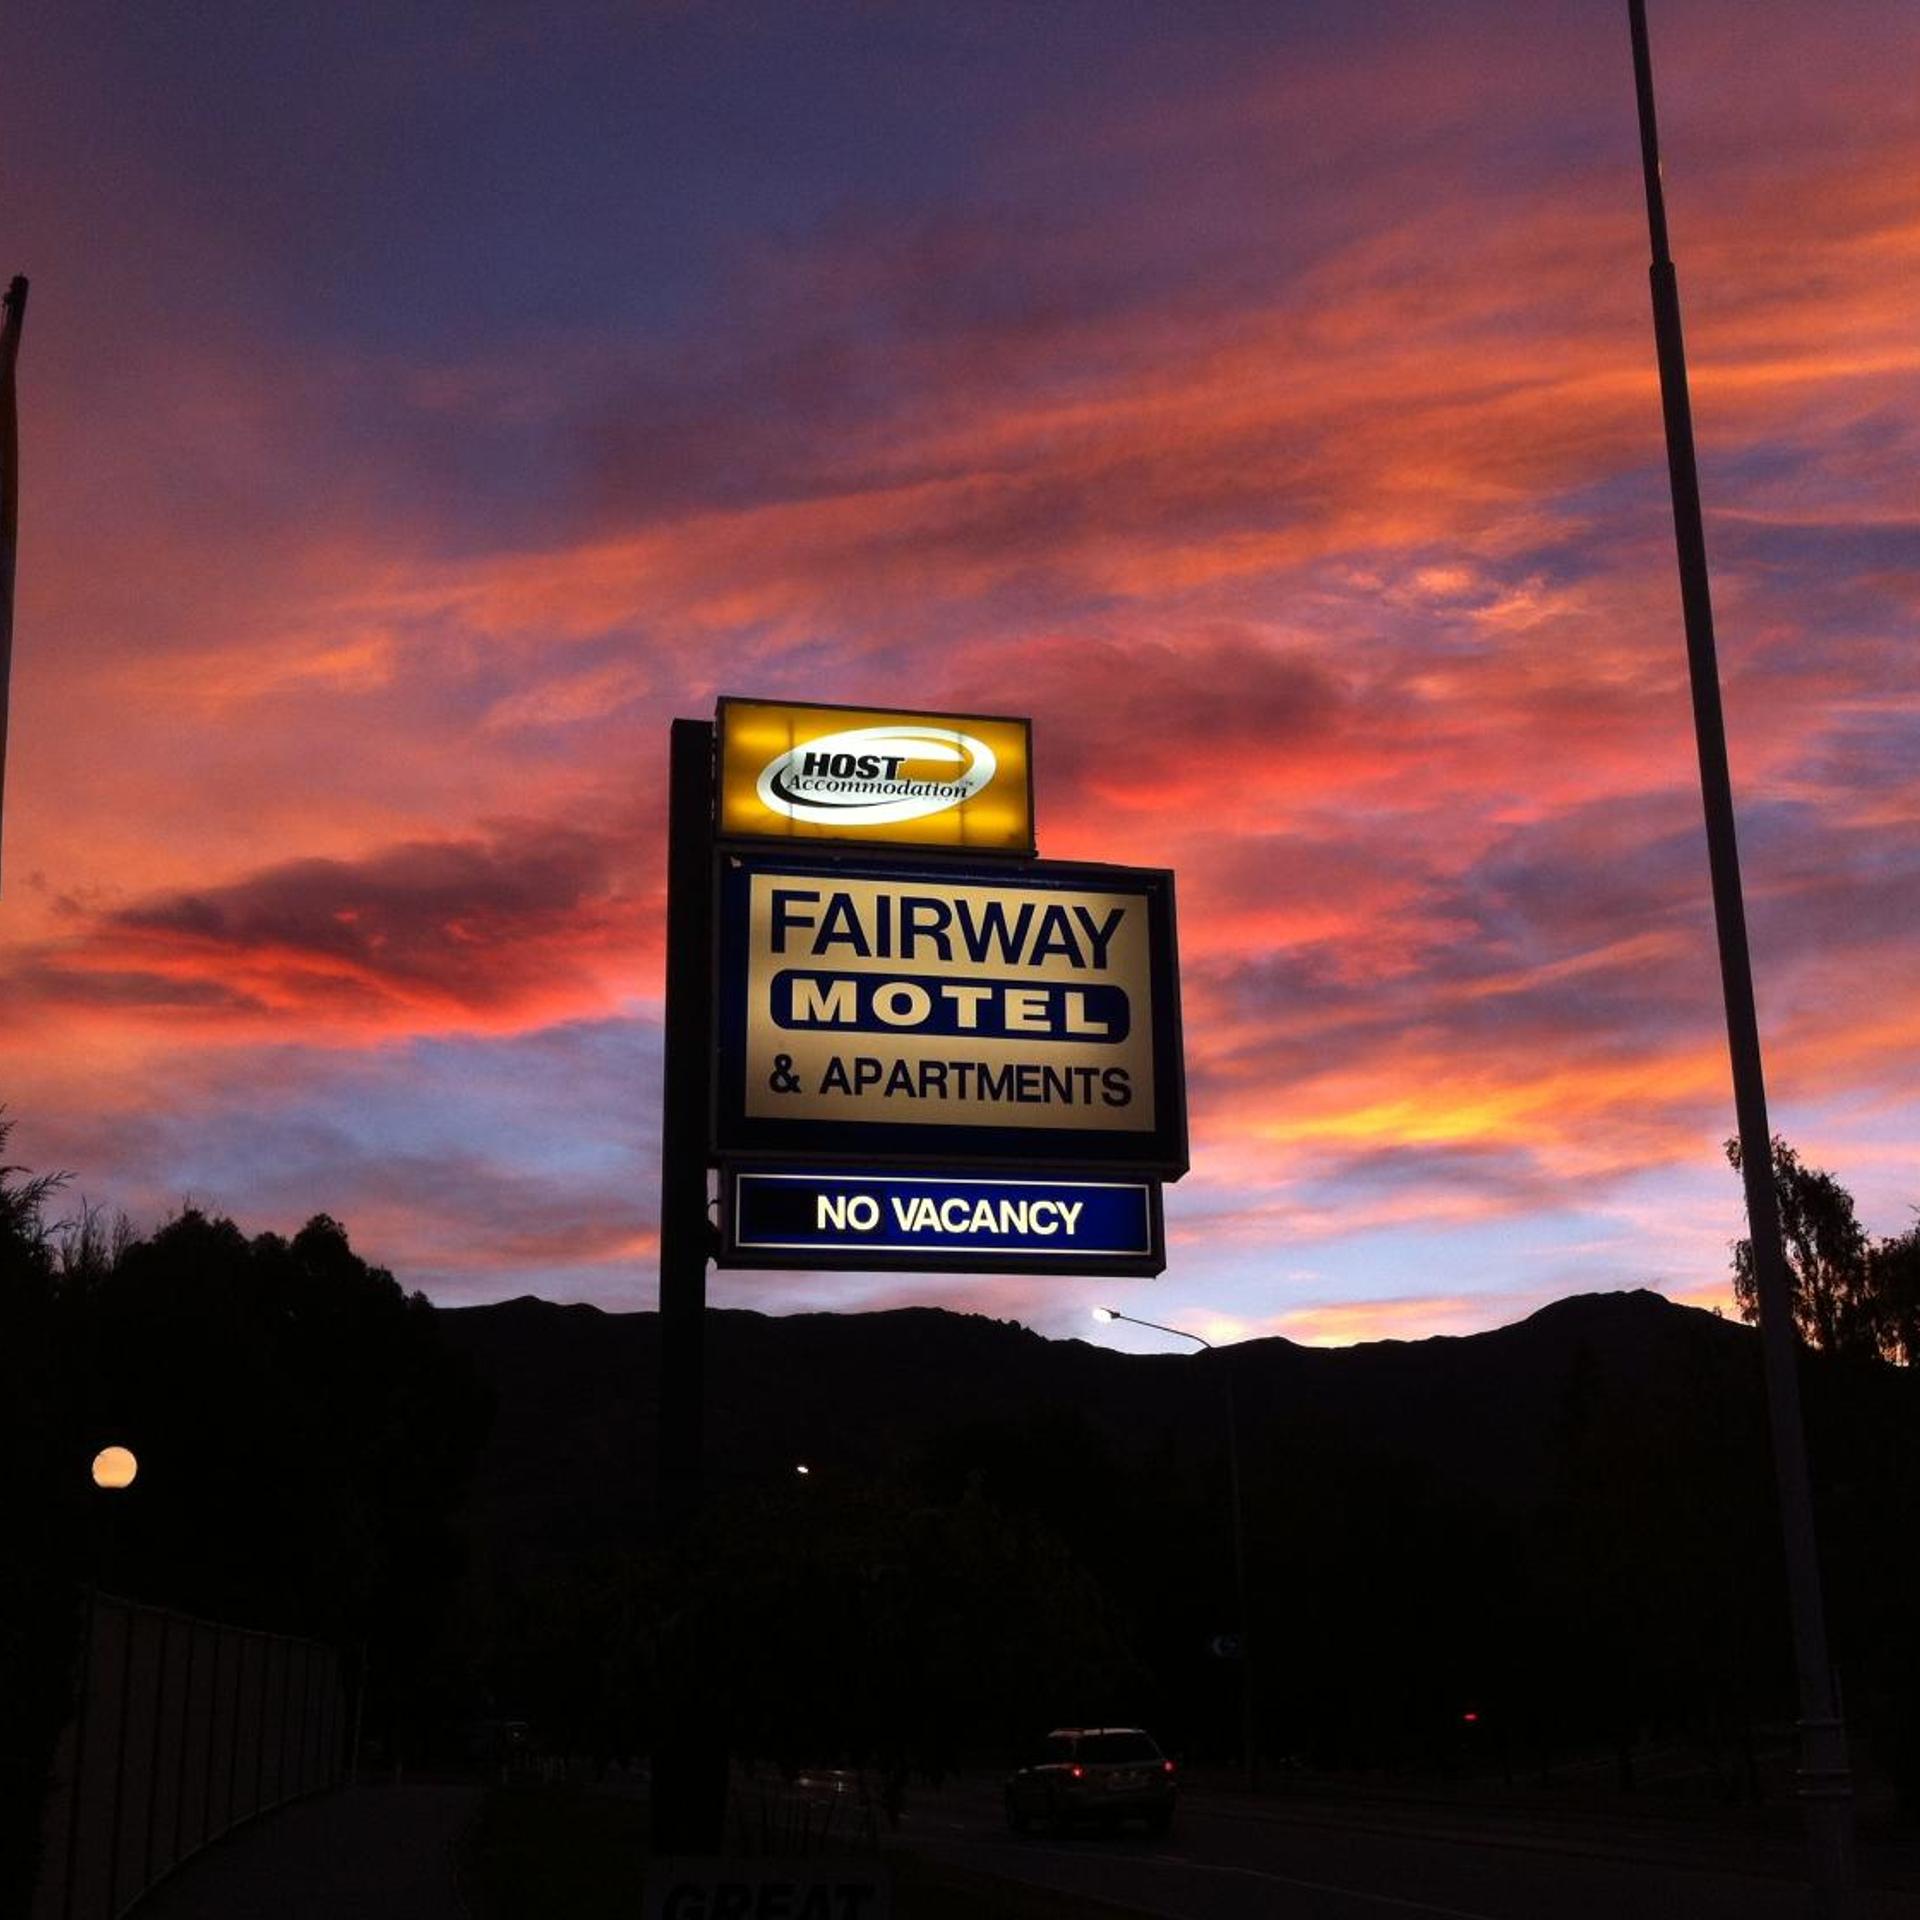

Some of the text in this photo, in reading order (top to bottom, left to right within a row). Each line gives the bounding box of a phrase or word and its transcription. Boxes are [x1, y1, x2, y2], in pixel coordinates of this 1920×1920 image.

[787, 773, 967, 799] Accommodation
[802, 752, 905, 780] HOST
[771, 889, 1125, 969] FAIRWAY
[791, 979, 1110, 1035] MOTEL
[769, 1053, 1132, 1108] & APARTMENTS
[817, 1194, 1084, 1236] NO VACANCY
[663, 1882, 877, 1920] GREAT
